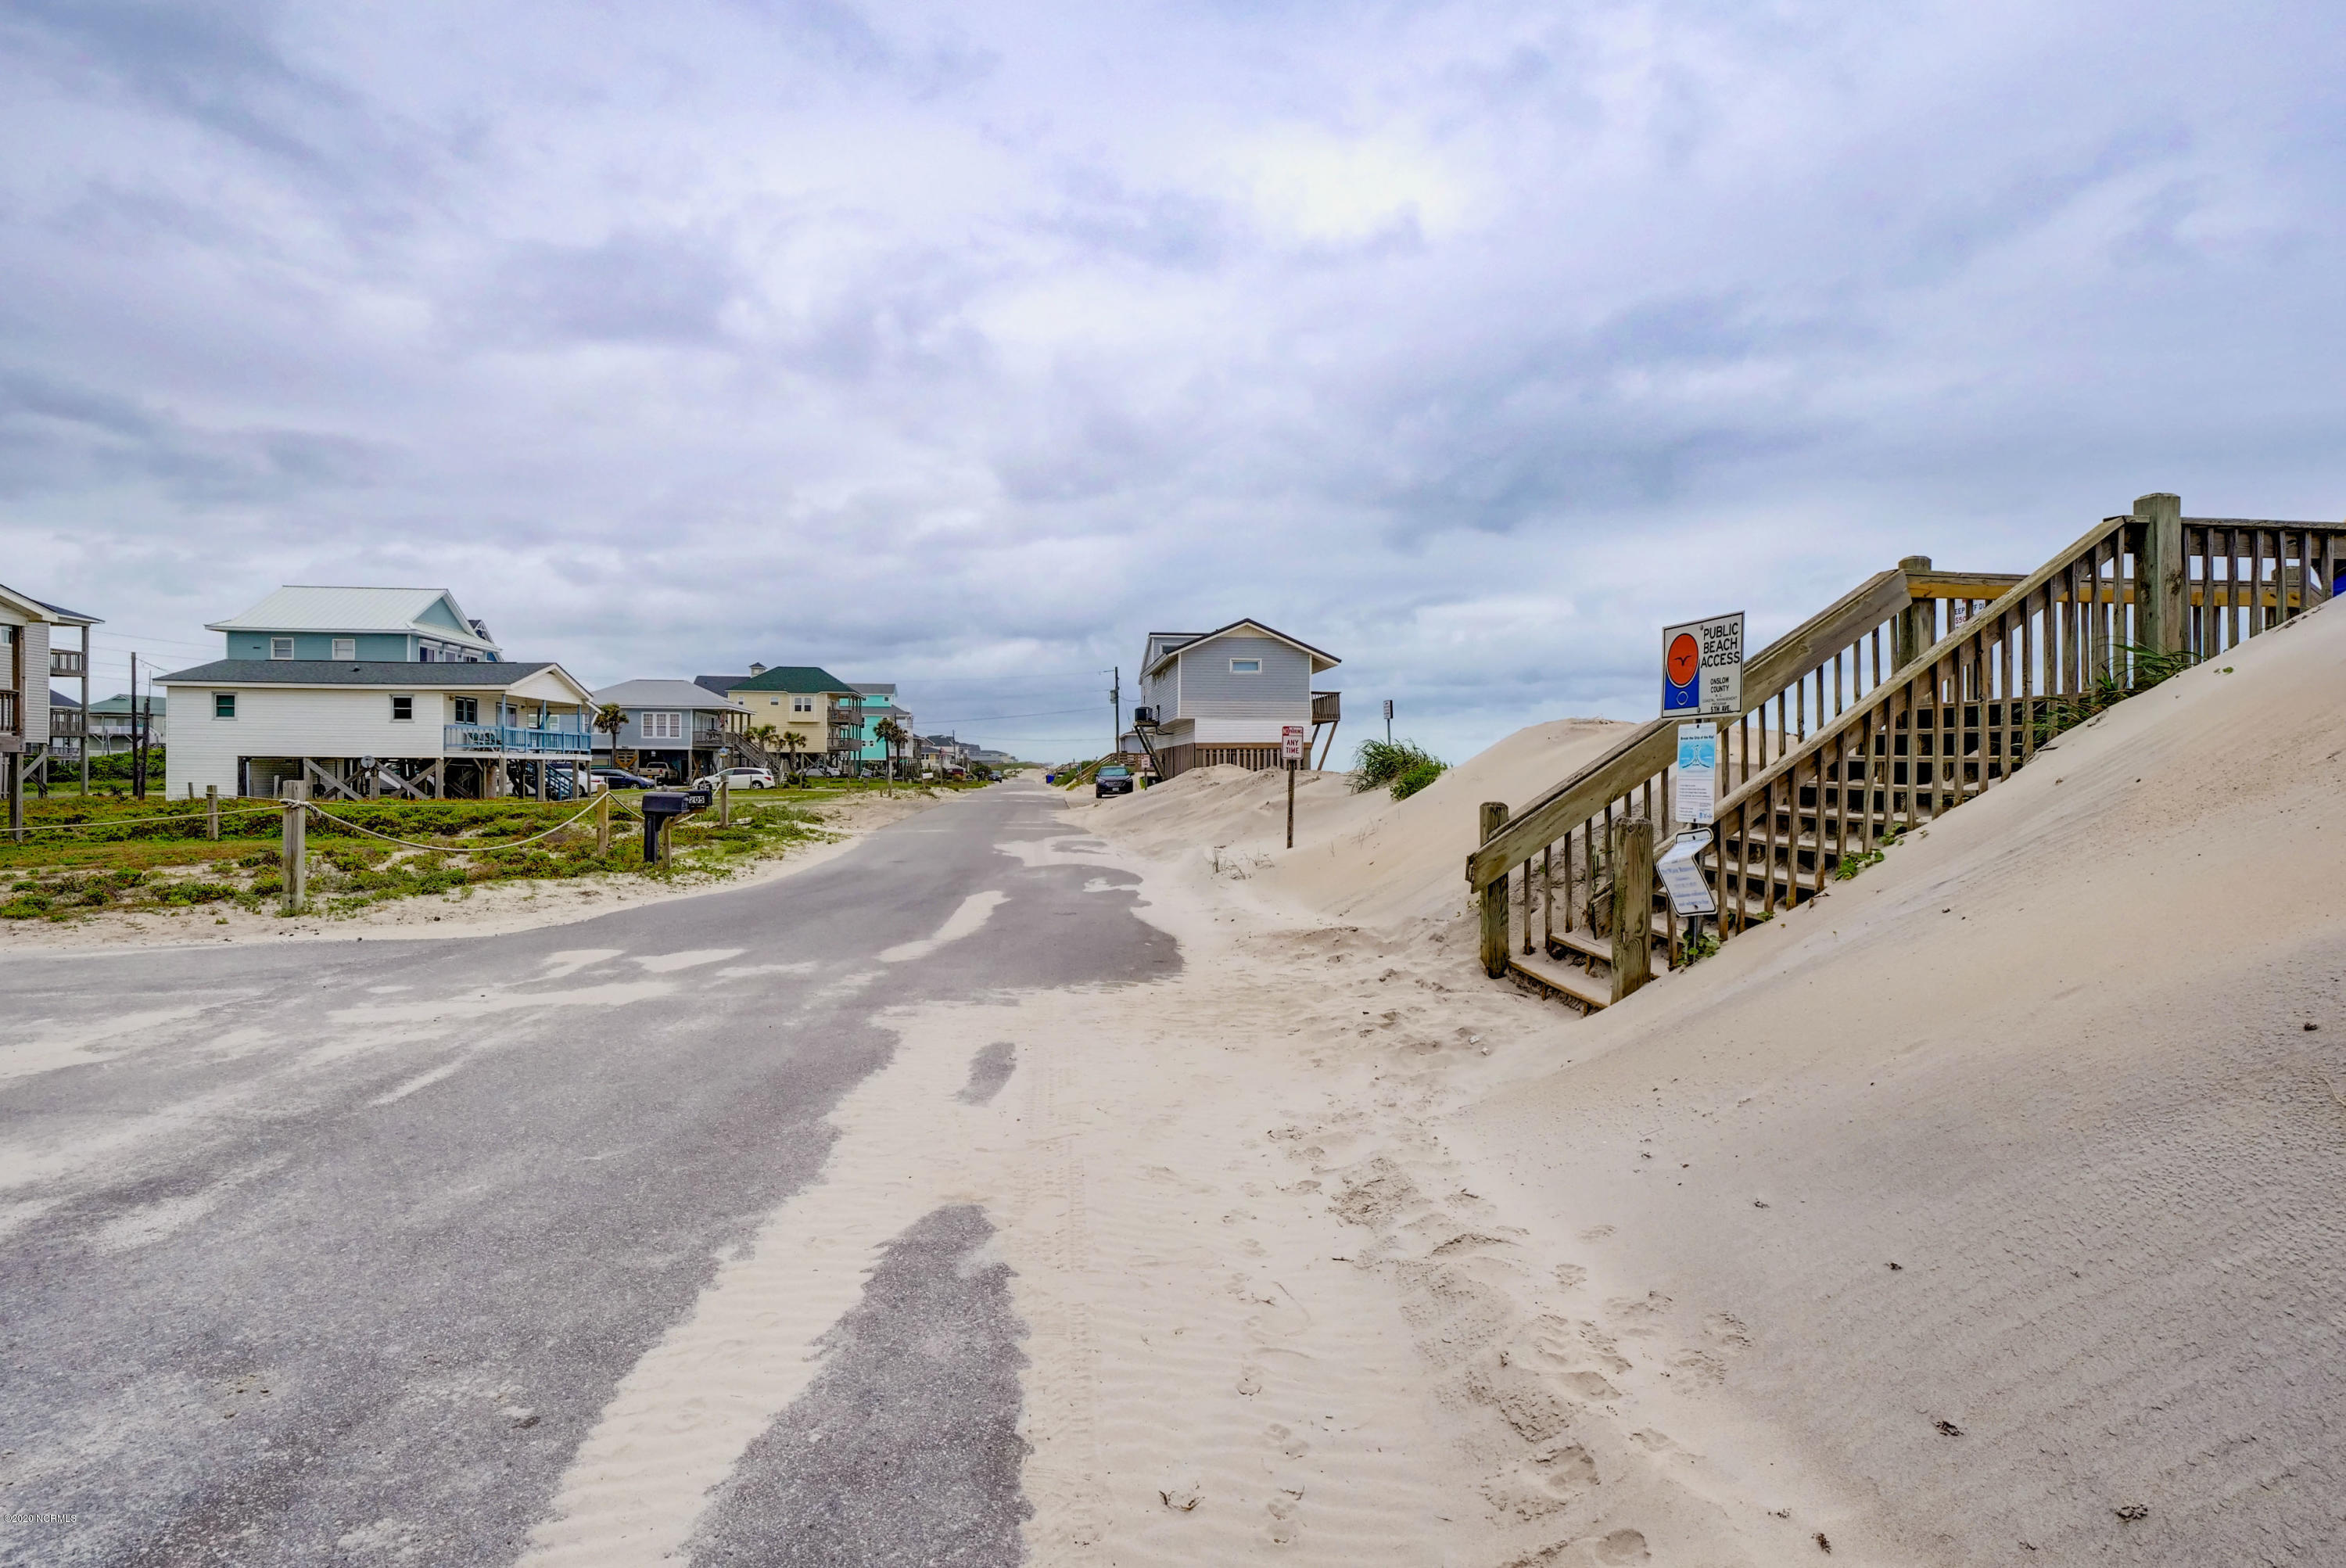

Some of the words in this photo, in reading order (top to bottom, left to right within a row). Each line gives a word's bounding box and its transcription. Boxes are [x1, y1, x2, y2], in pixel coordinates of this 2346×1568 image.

[1703, 622, 1738, 640] PUBLIC
[1703, 637, 1738, 654] BEACH
[1700, 651, 1740, 669] ACCESS
[1710, 676, 1730, 685] ONSLOW
[1710, 685, 1730, 694] COUNTY
